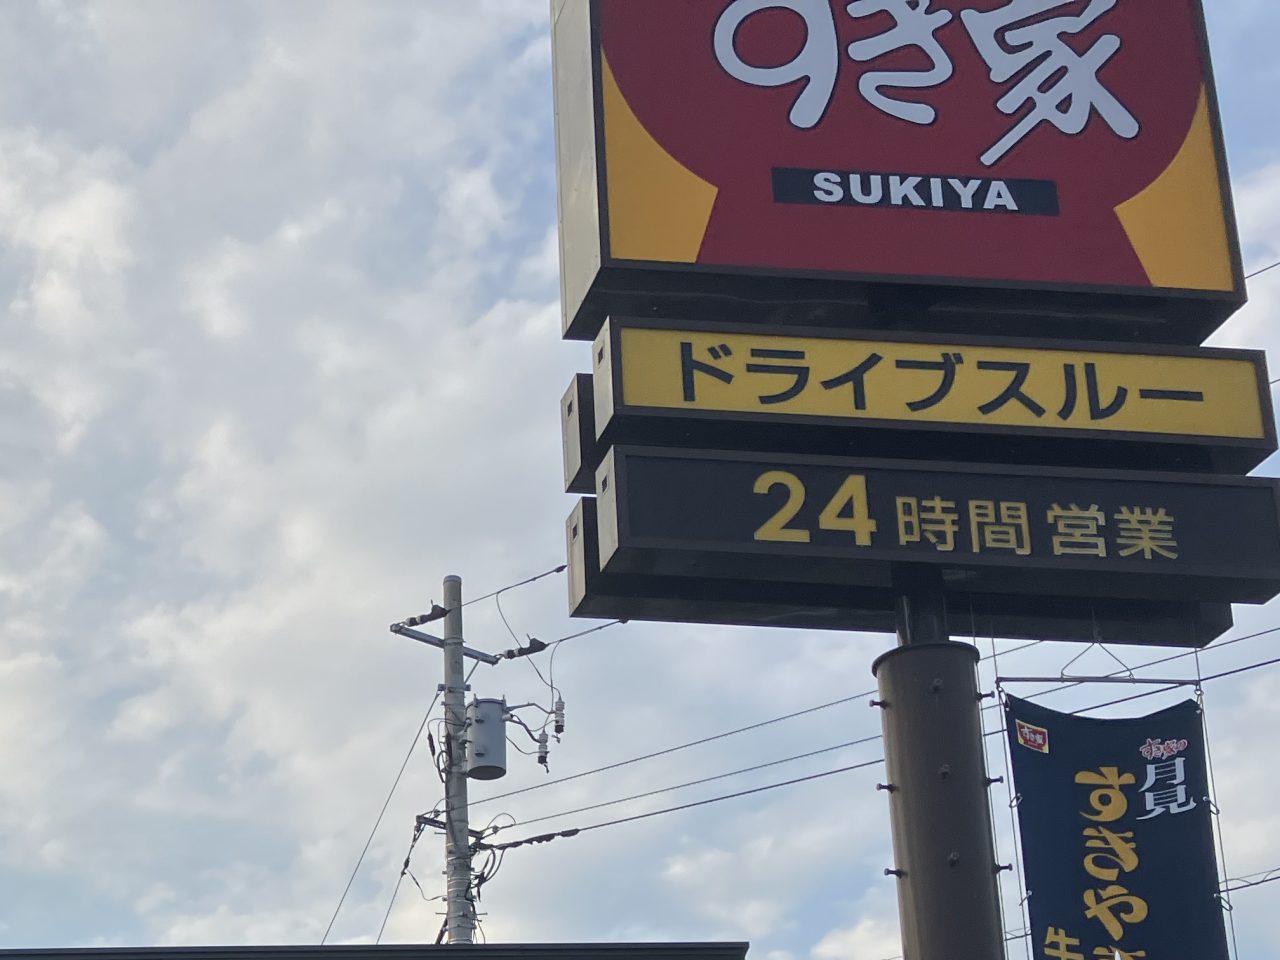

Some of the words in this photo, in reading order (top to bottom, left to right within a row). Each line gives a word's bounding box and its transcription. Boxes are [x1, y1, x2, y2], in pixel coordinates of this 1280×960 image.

[812, 172, 1019, 212] SUKIYA
[680, 341, 1205, 422] ドライブスルー
[752, 469, 1179, 562] 24時間営業
[1135, 757, 1197, 820] 月見
